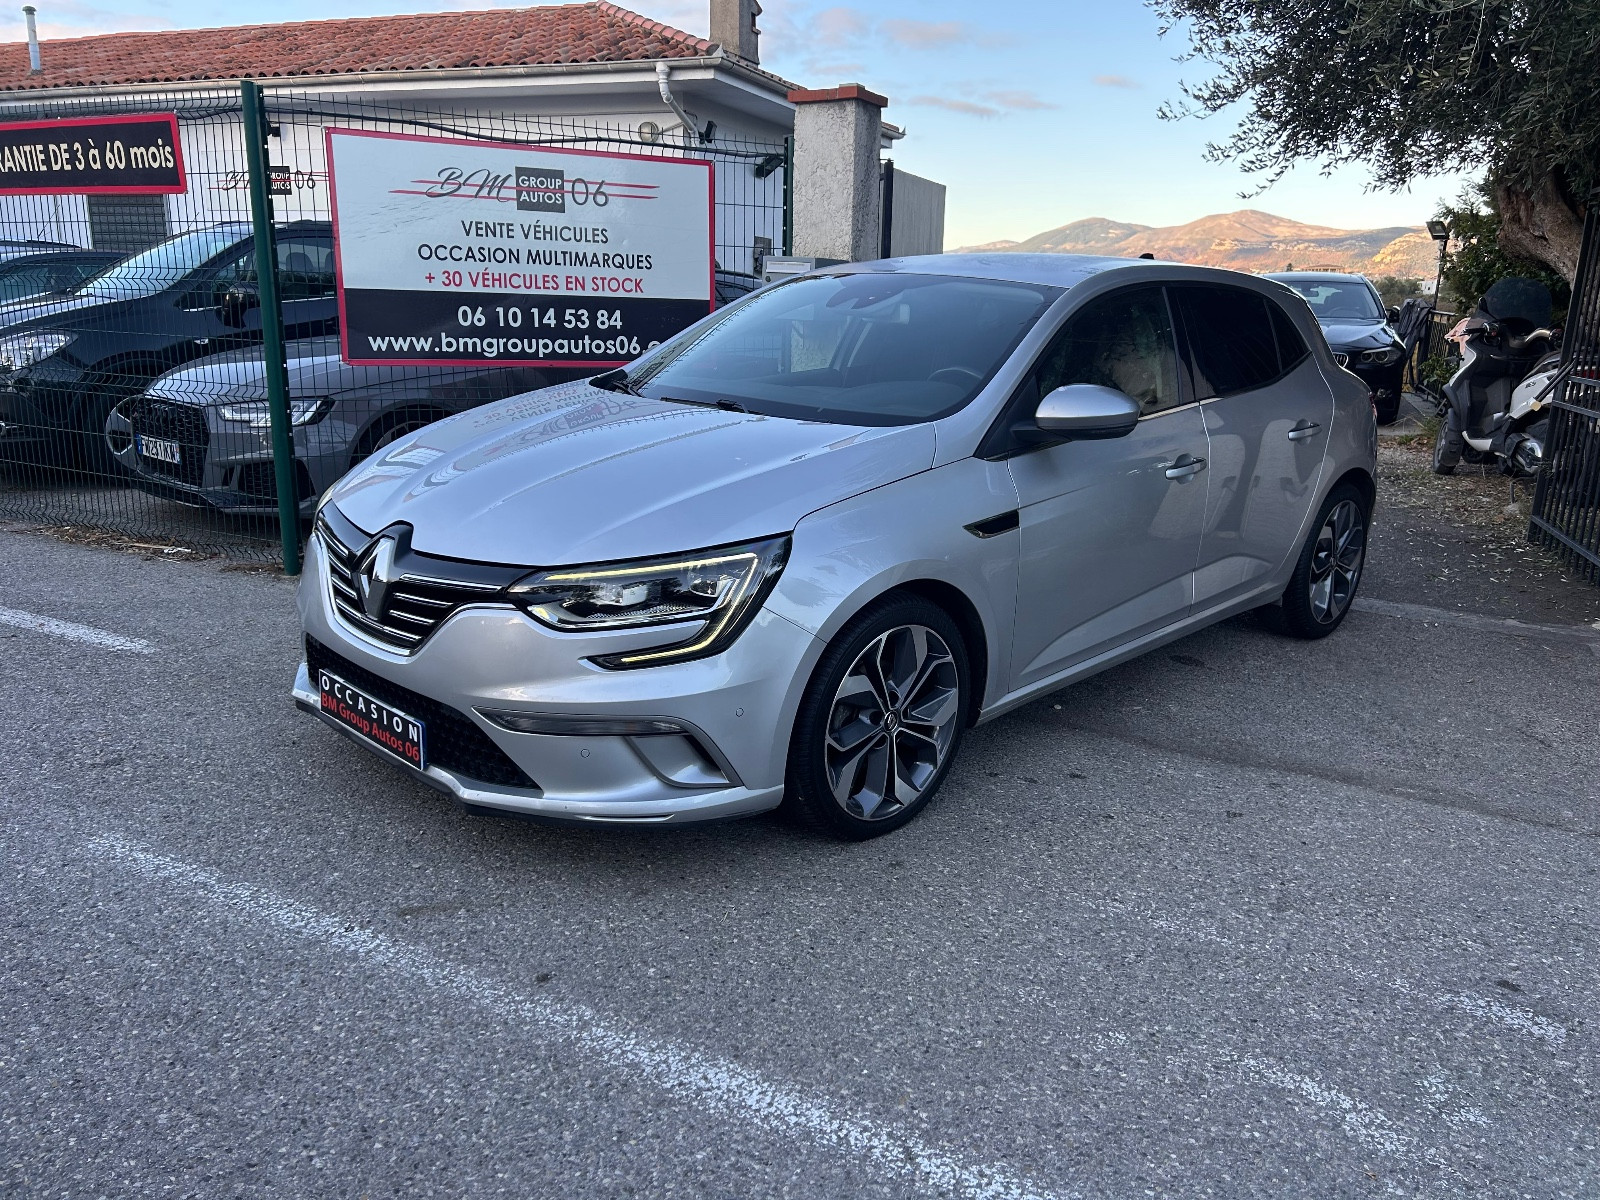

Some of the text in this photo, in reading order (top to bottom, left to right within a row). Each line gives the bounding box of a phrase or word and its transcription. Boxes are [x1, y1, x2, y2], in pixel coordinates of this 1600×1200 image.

[48, 143, 72, 171] DE
[73, 141, 85, 171] 3
[87, 138, 102, 170] à
[105, 140, 126, 170] 60
[129, 137, 174, 169] mois
[295, 170, 316, 189] 06
[425, 167, 609, 207] BM GROUP 06
[519, 189, 563, 205] AUTOS
[461, 219, 609, 245] VENTE VÉHICULES
[417, 243, 653, 270] OCCASION MULTIMARQUES
[424, 268, 644, 294] + 30 VÉHICULES EN STOCK
[457, 305, 623, 330] 06 10 14 53 84
[321, 675, 418, 743] OCCASION
[321, 692, 420, 762] BM Group Autos 06
